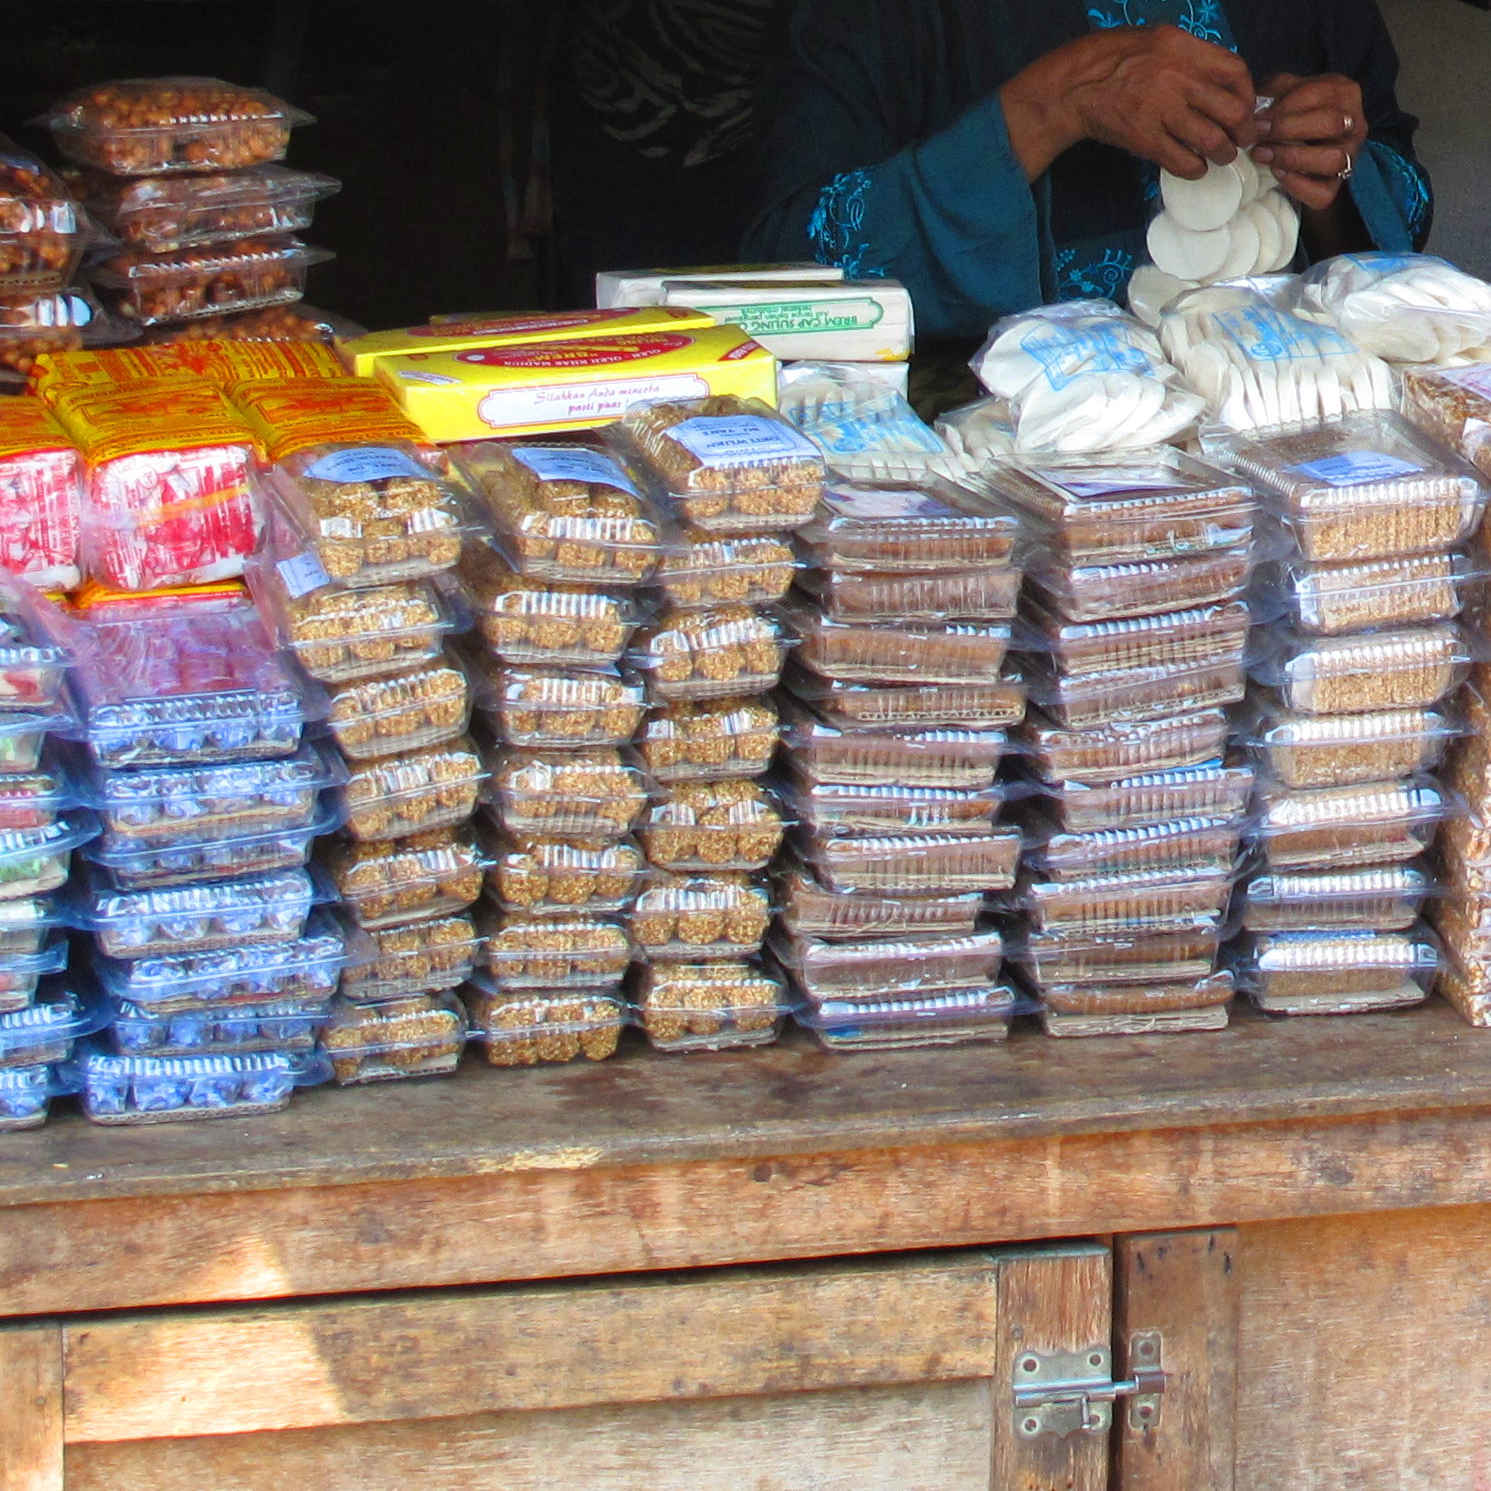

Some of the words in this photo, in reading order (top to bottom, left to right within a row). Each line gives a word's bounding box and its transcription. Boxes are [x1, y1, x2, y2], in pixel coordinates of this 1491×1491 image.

[755, 318, 795, 331] SULING
[799, 317, 822, 327] CAP
[824, 316, 858, 326] BREM
[587, 387, 615, 401] Anda
[567, 402, 595, 415] pasti
